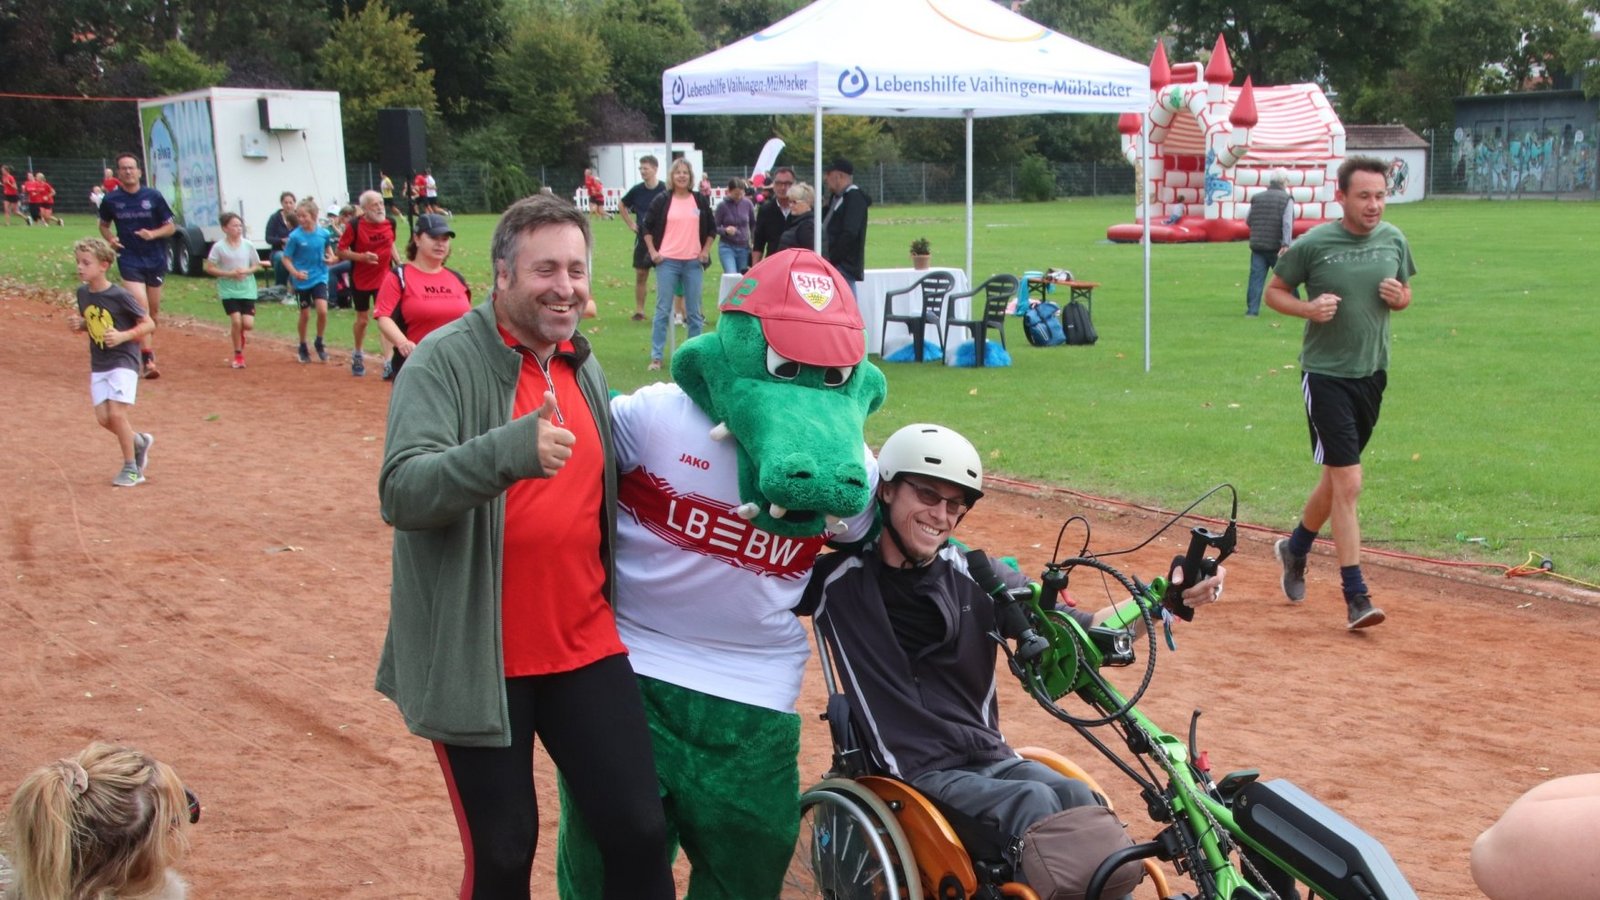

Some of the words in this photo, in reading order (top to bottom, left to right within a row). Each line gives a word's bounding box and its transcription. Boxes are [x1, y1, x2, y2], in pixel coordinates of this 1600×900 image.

[687, 76, 727, 98] Lebenshilfe
[727, 73, 808, 96] Vaihingen-Mühlacker
[875, 75, 967, 94] Lebenshilfe
[970, 77, 1133, 99] Vaihingen-Mühlacker
[679, 453, 710, 471] JAKO
